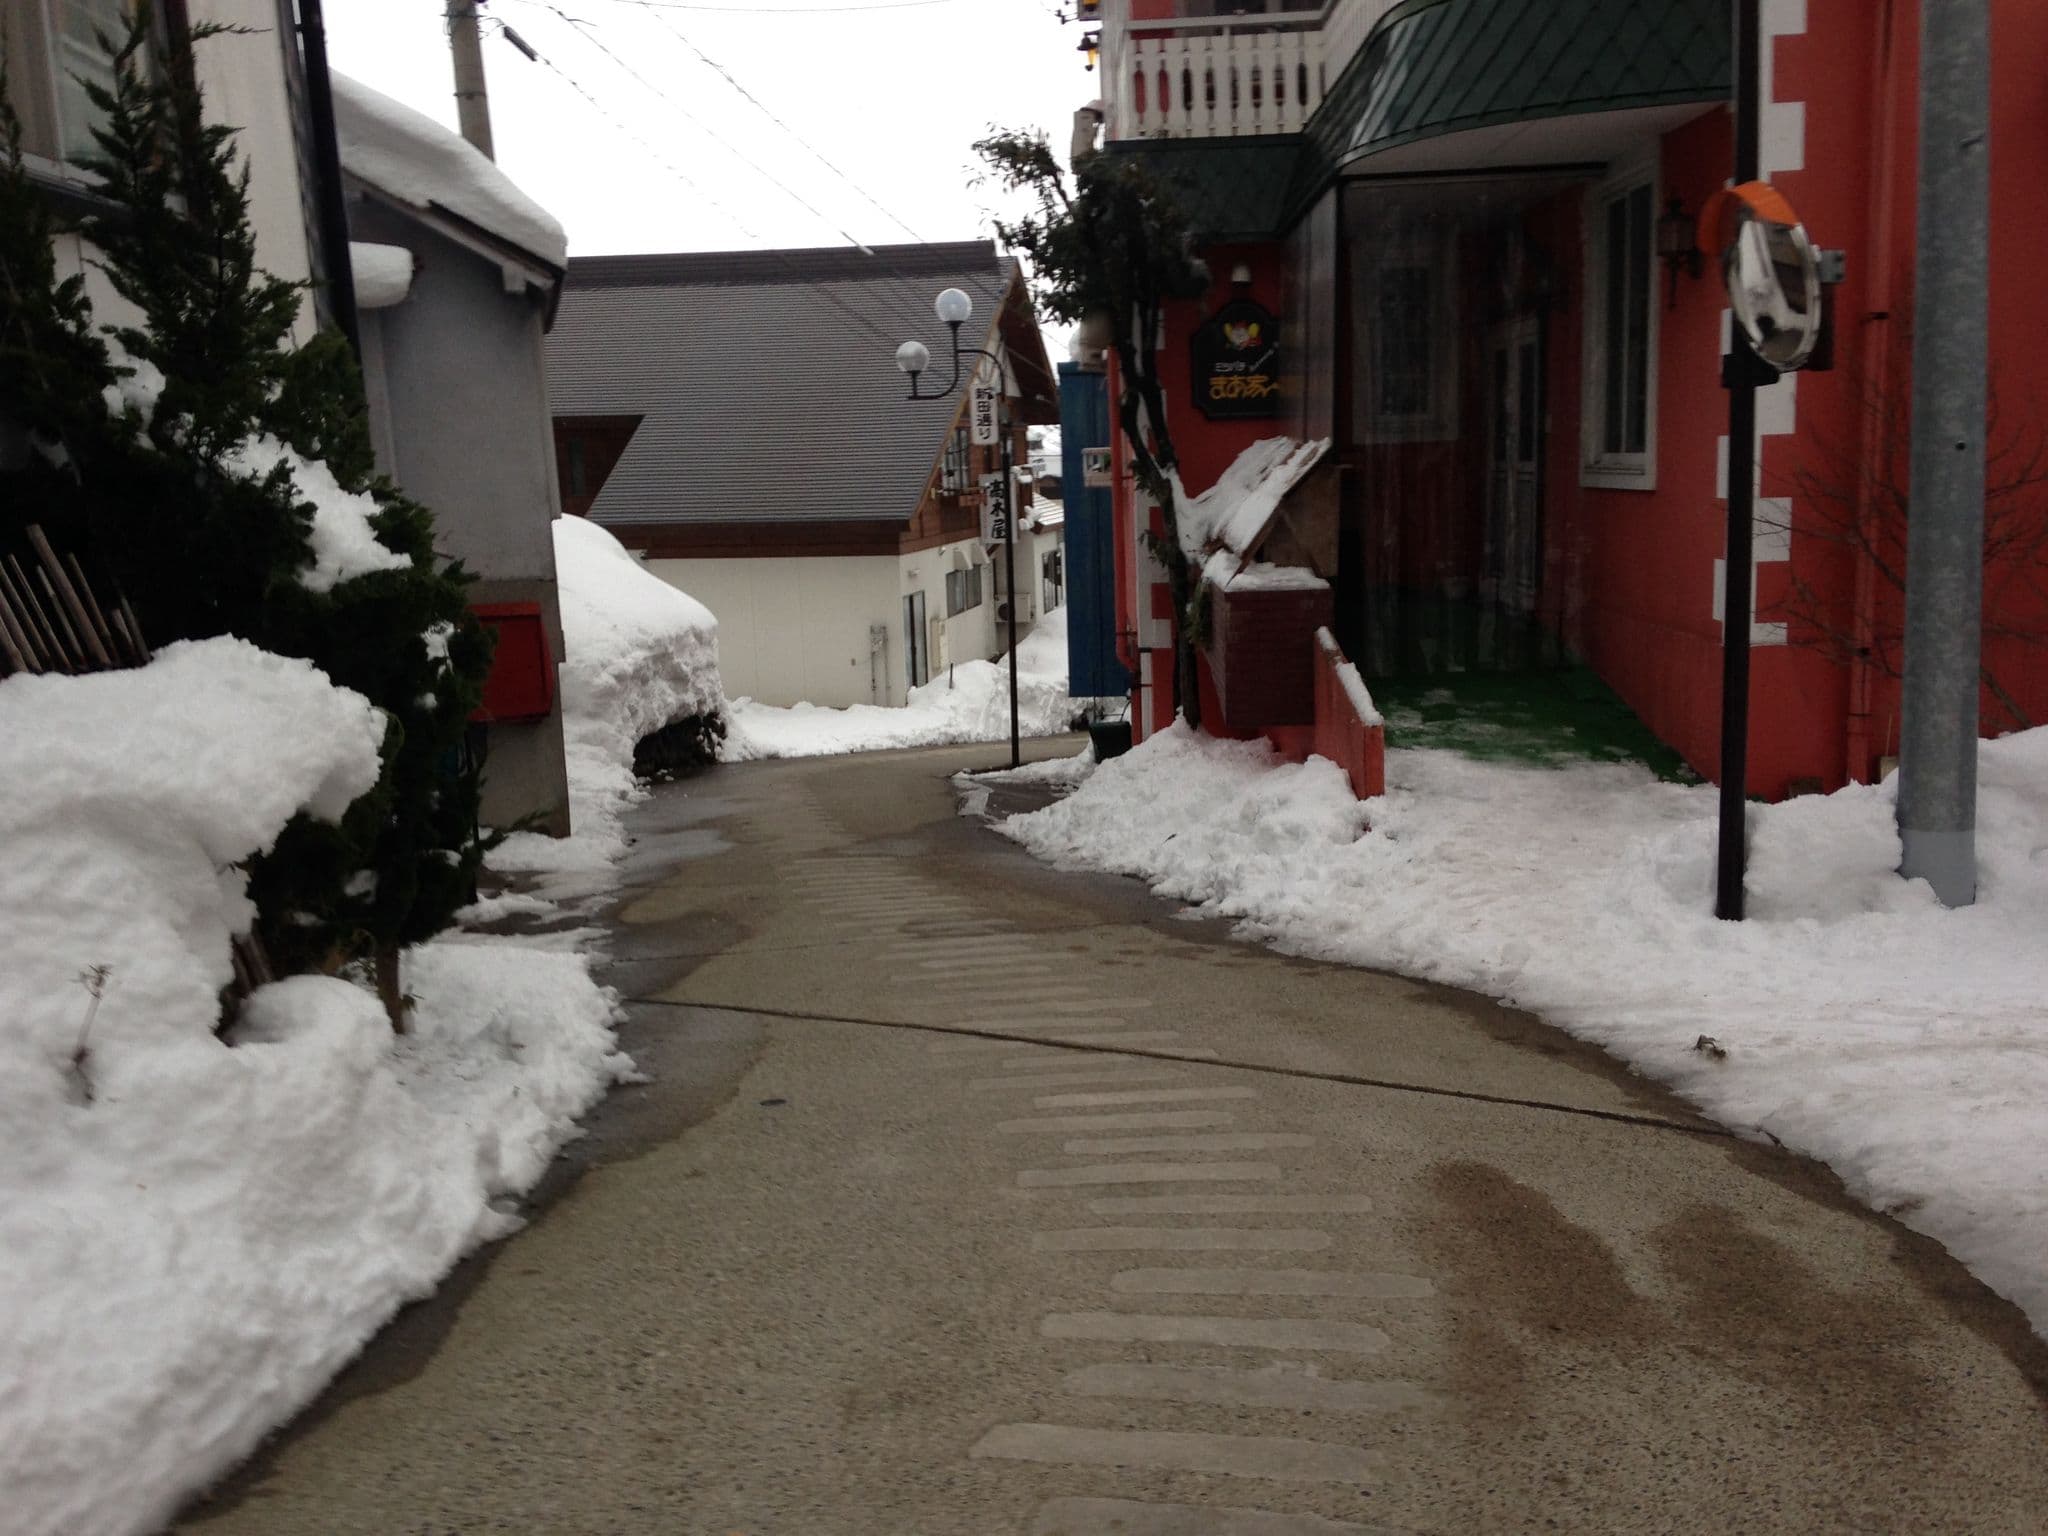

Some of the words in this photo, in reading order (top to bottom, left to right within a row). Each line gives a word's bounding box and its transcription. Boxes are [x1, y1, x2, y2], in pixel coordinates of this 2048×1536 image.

[976, 387, 993, 440] 新田通り
[989, 479, 1007, 539] 高木屋
